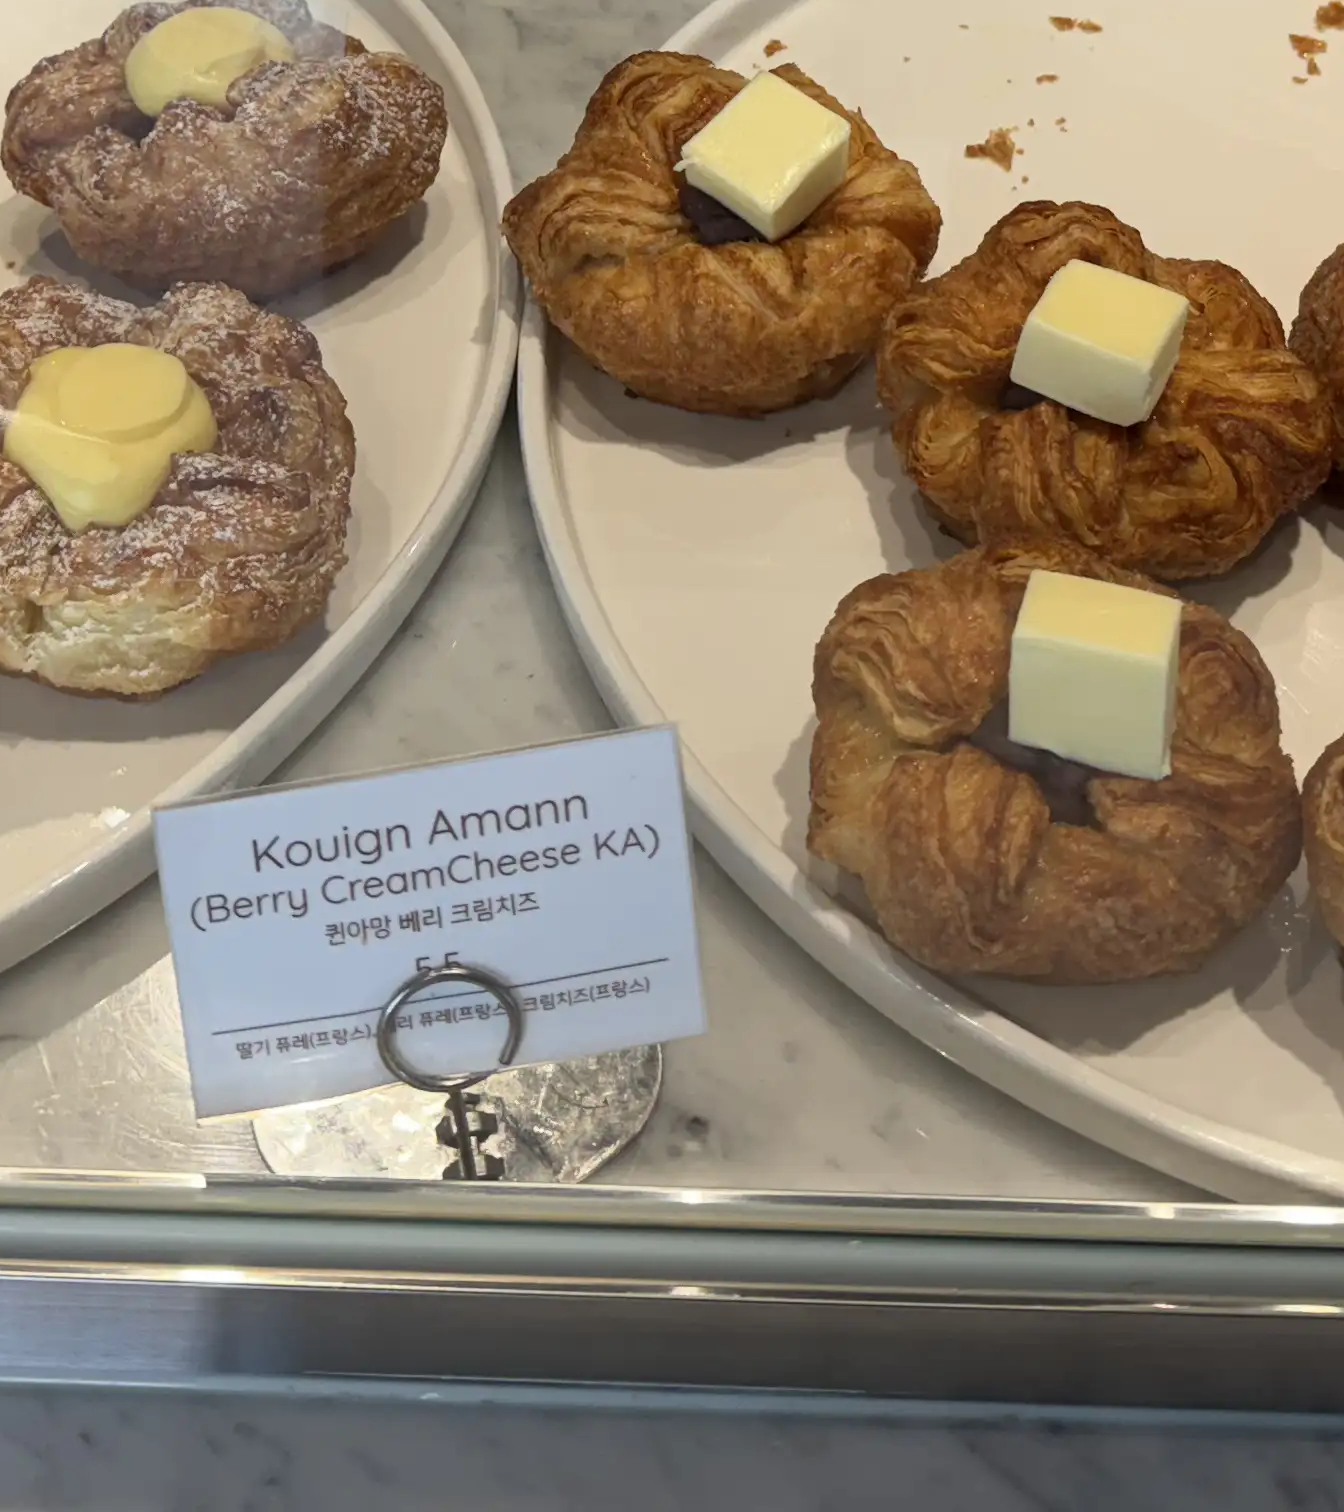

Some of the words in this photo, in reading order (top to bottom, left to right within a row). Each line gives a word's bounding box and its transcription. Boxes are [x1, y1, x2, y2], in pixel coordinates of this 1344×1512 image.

[252, 824, 412, 873] Kouign
[428, 794, 589, 846] Amann
[190, 888, 309, 932] (Berry
[321, 843, 581, 905] CreamCheese
[593, 824, 660, 860] KA)
[324, 915, 392, 947] 퀸아망
[399, 906, 443, 933] 베리
[450, 891, 541, 923] 크림치즈
[414, 951, 461, 973] 55
[235, 1040, 271, 1060] 딸기
[522, 976, 652, 1013] 크림치즈(프랑스)
